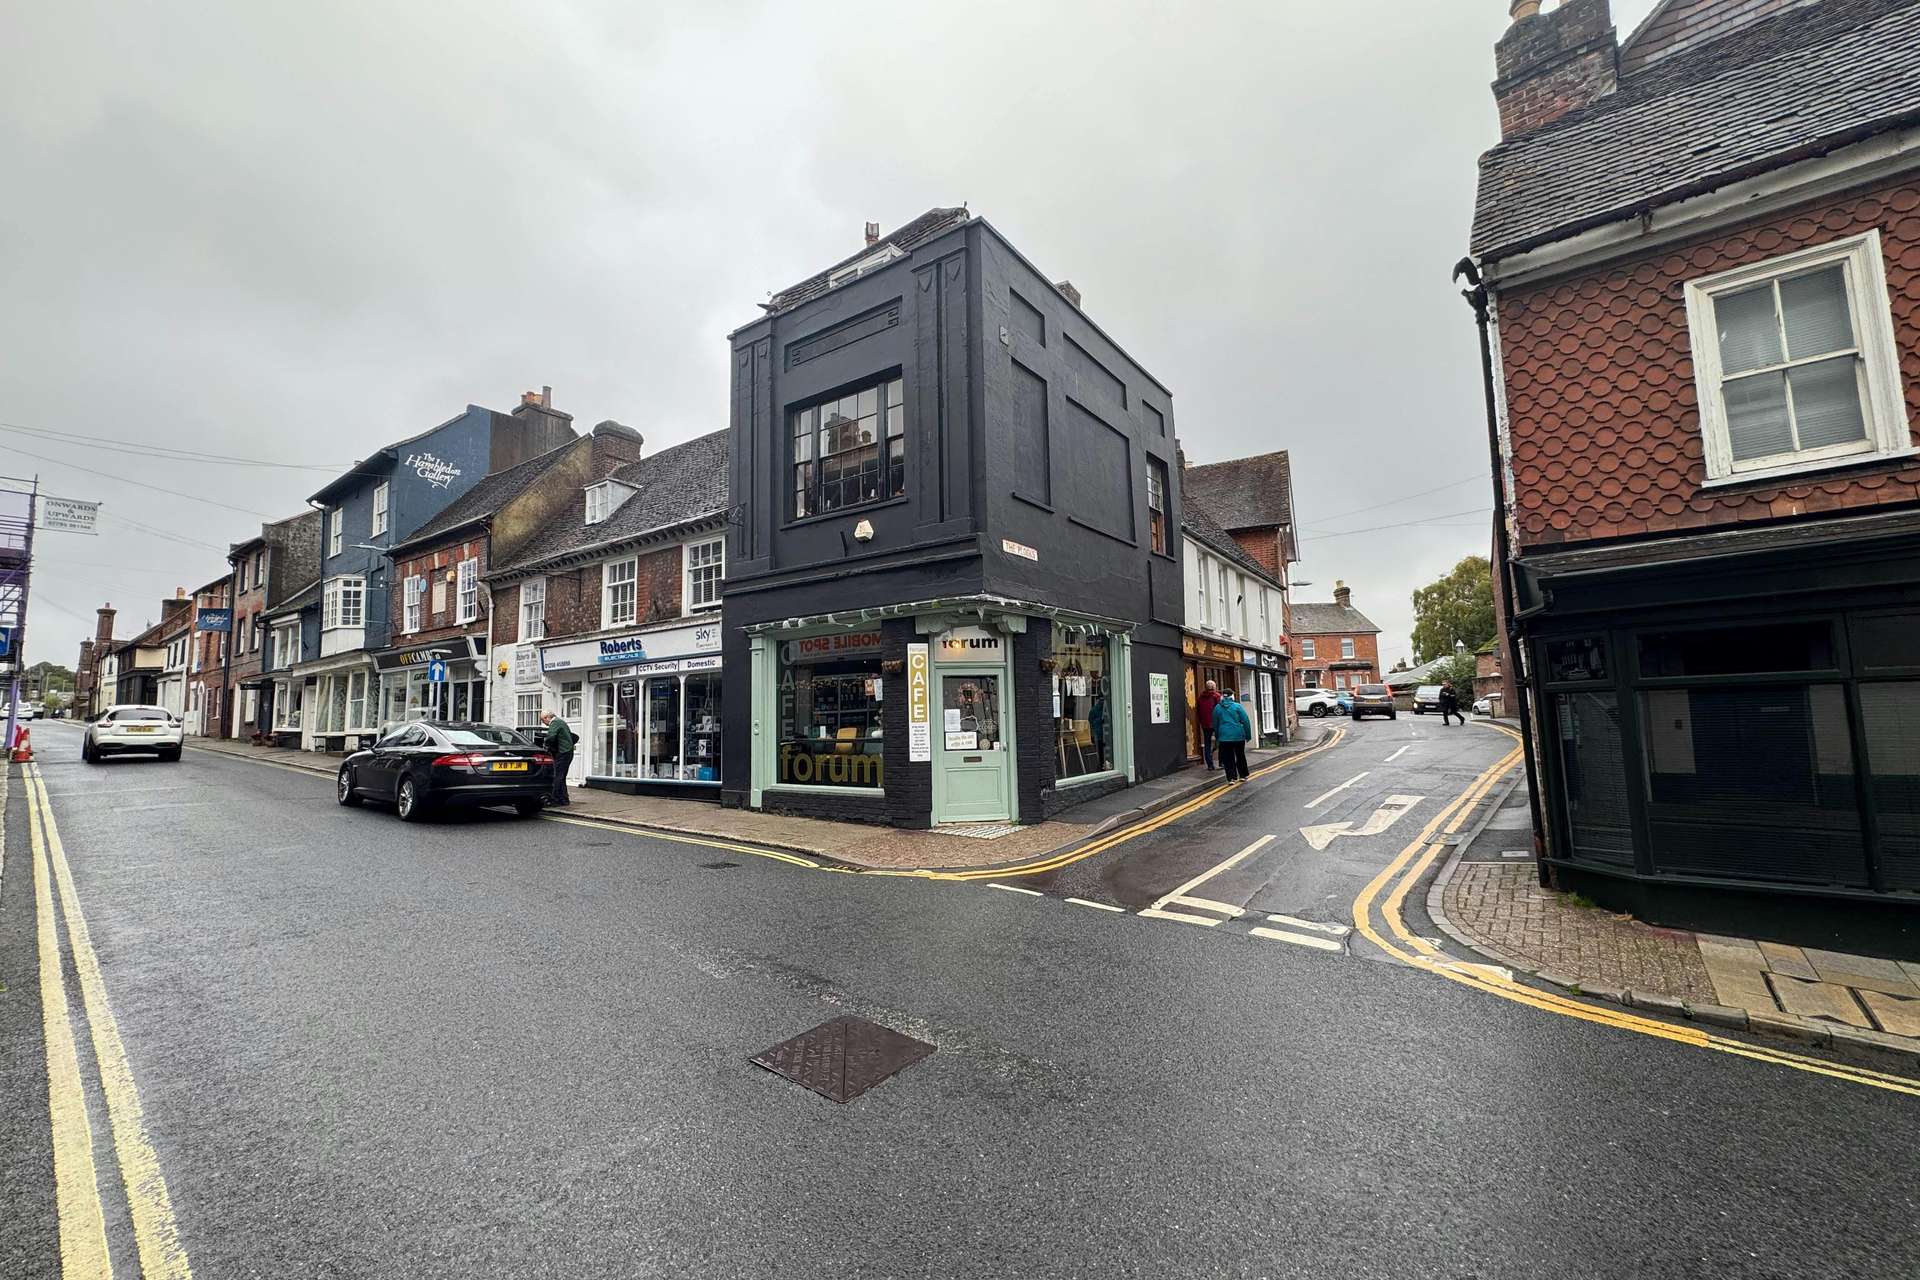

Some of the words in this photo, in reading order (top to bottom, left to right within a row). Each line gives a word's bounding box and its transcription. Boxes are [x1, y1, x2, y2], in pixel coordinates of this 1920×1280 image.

[404, 454, 461, 475] Hambledon
[424, 453, 435, 461] The
[417, 467, 454, 489] Gallery
[46, 501, 97, 511] ONWARDS
[47, 511, 96, 521] UPWARDS
[696, 627, 711, 642] sky
[600, 637, 642, 655] Roberts
[639, 664, 654, 673] CCTV
[654, 661, 678, 671] Security
[687, 659, 716, 668] Domestic
[780, 645, 797, 741] CAFE
[911, 655, 926, 719] CAFE
[779, 744, 883, 785] forum
